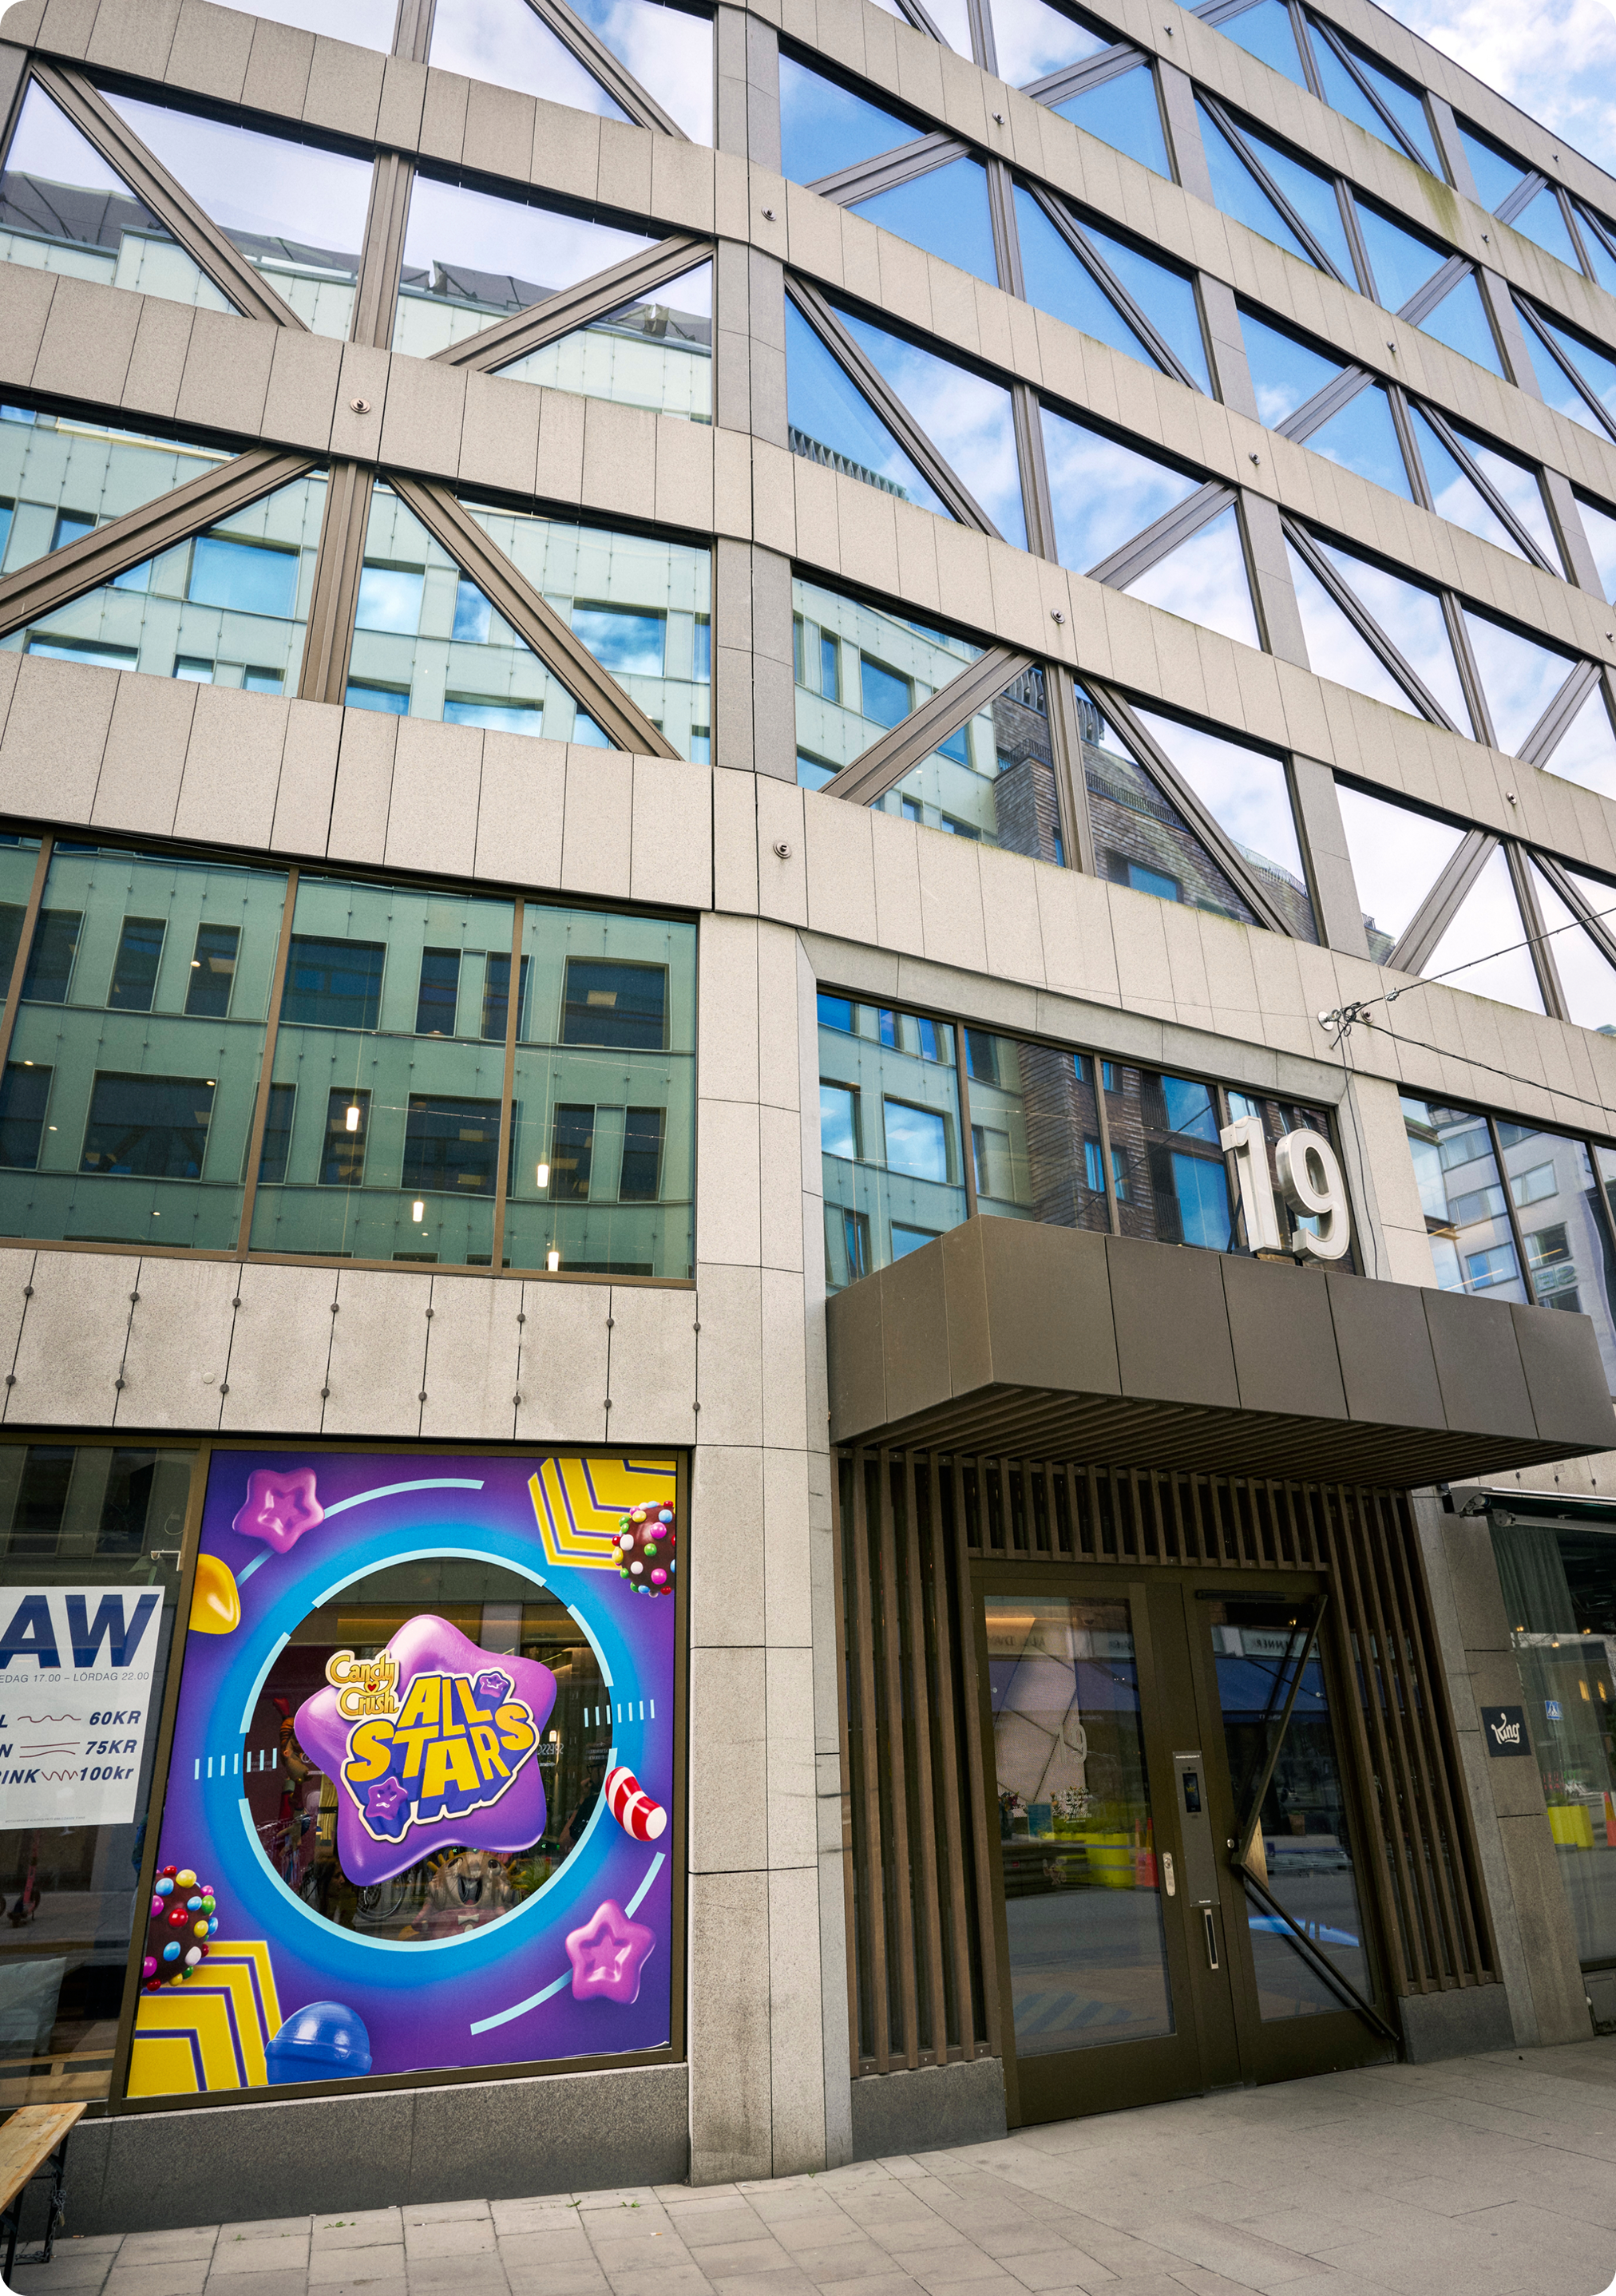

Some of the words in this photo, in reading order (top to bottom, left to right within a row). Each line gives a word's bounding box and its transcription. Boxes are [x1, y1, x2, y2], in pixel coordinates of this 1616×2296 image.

[1220, 1115, 1350, 1264] 19
[0, 1594, 160, 1670] AW
[34, 1673, 61, 1683] 17.00
[73, 1672, 118, 1682] LÖRDAG
[121, 1672, 150, 1680] 22.00
[330, 1654, 396, 1685] Candy
[340, 1687, 400, 1716] Crush
[397, 1676, 493, 1737] ALL
[89, 1710, 142, 1727] 60KR
[1491, 1712, 1520, 1744] King
[85, 1739, 138, 1755] 75KR
[347, 1703, 535, 1799] STARS
[1056, 1723, 1088, 1764] 19
[0, 1769, 40, 1784] INK
[80, 1766, 134, 1781] 100kr
